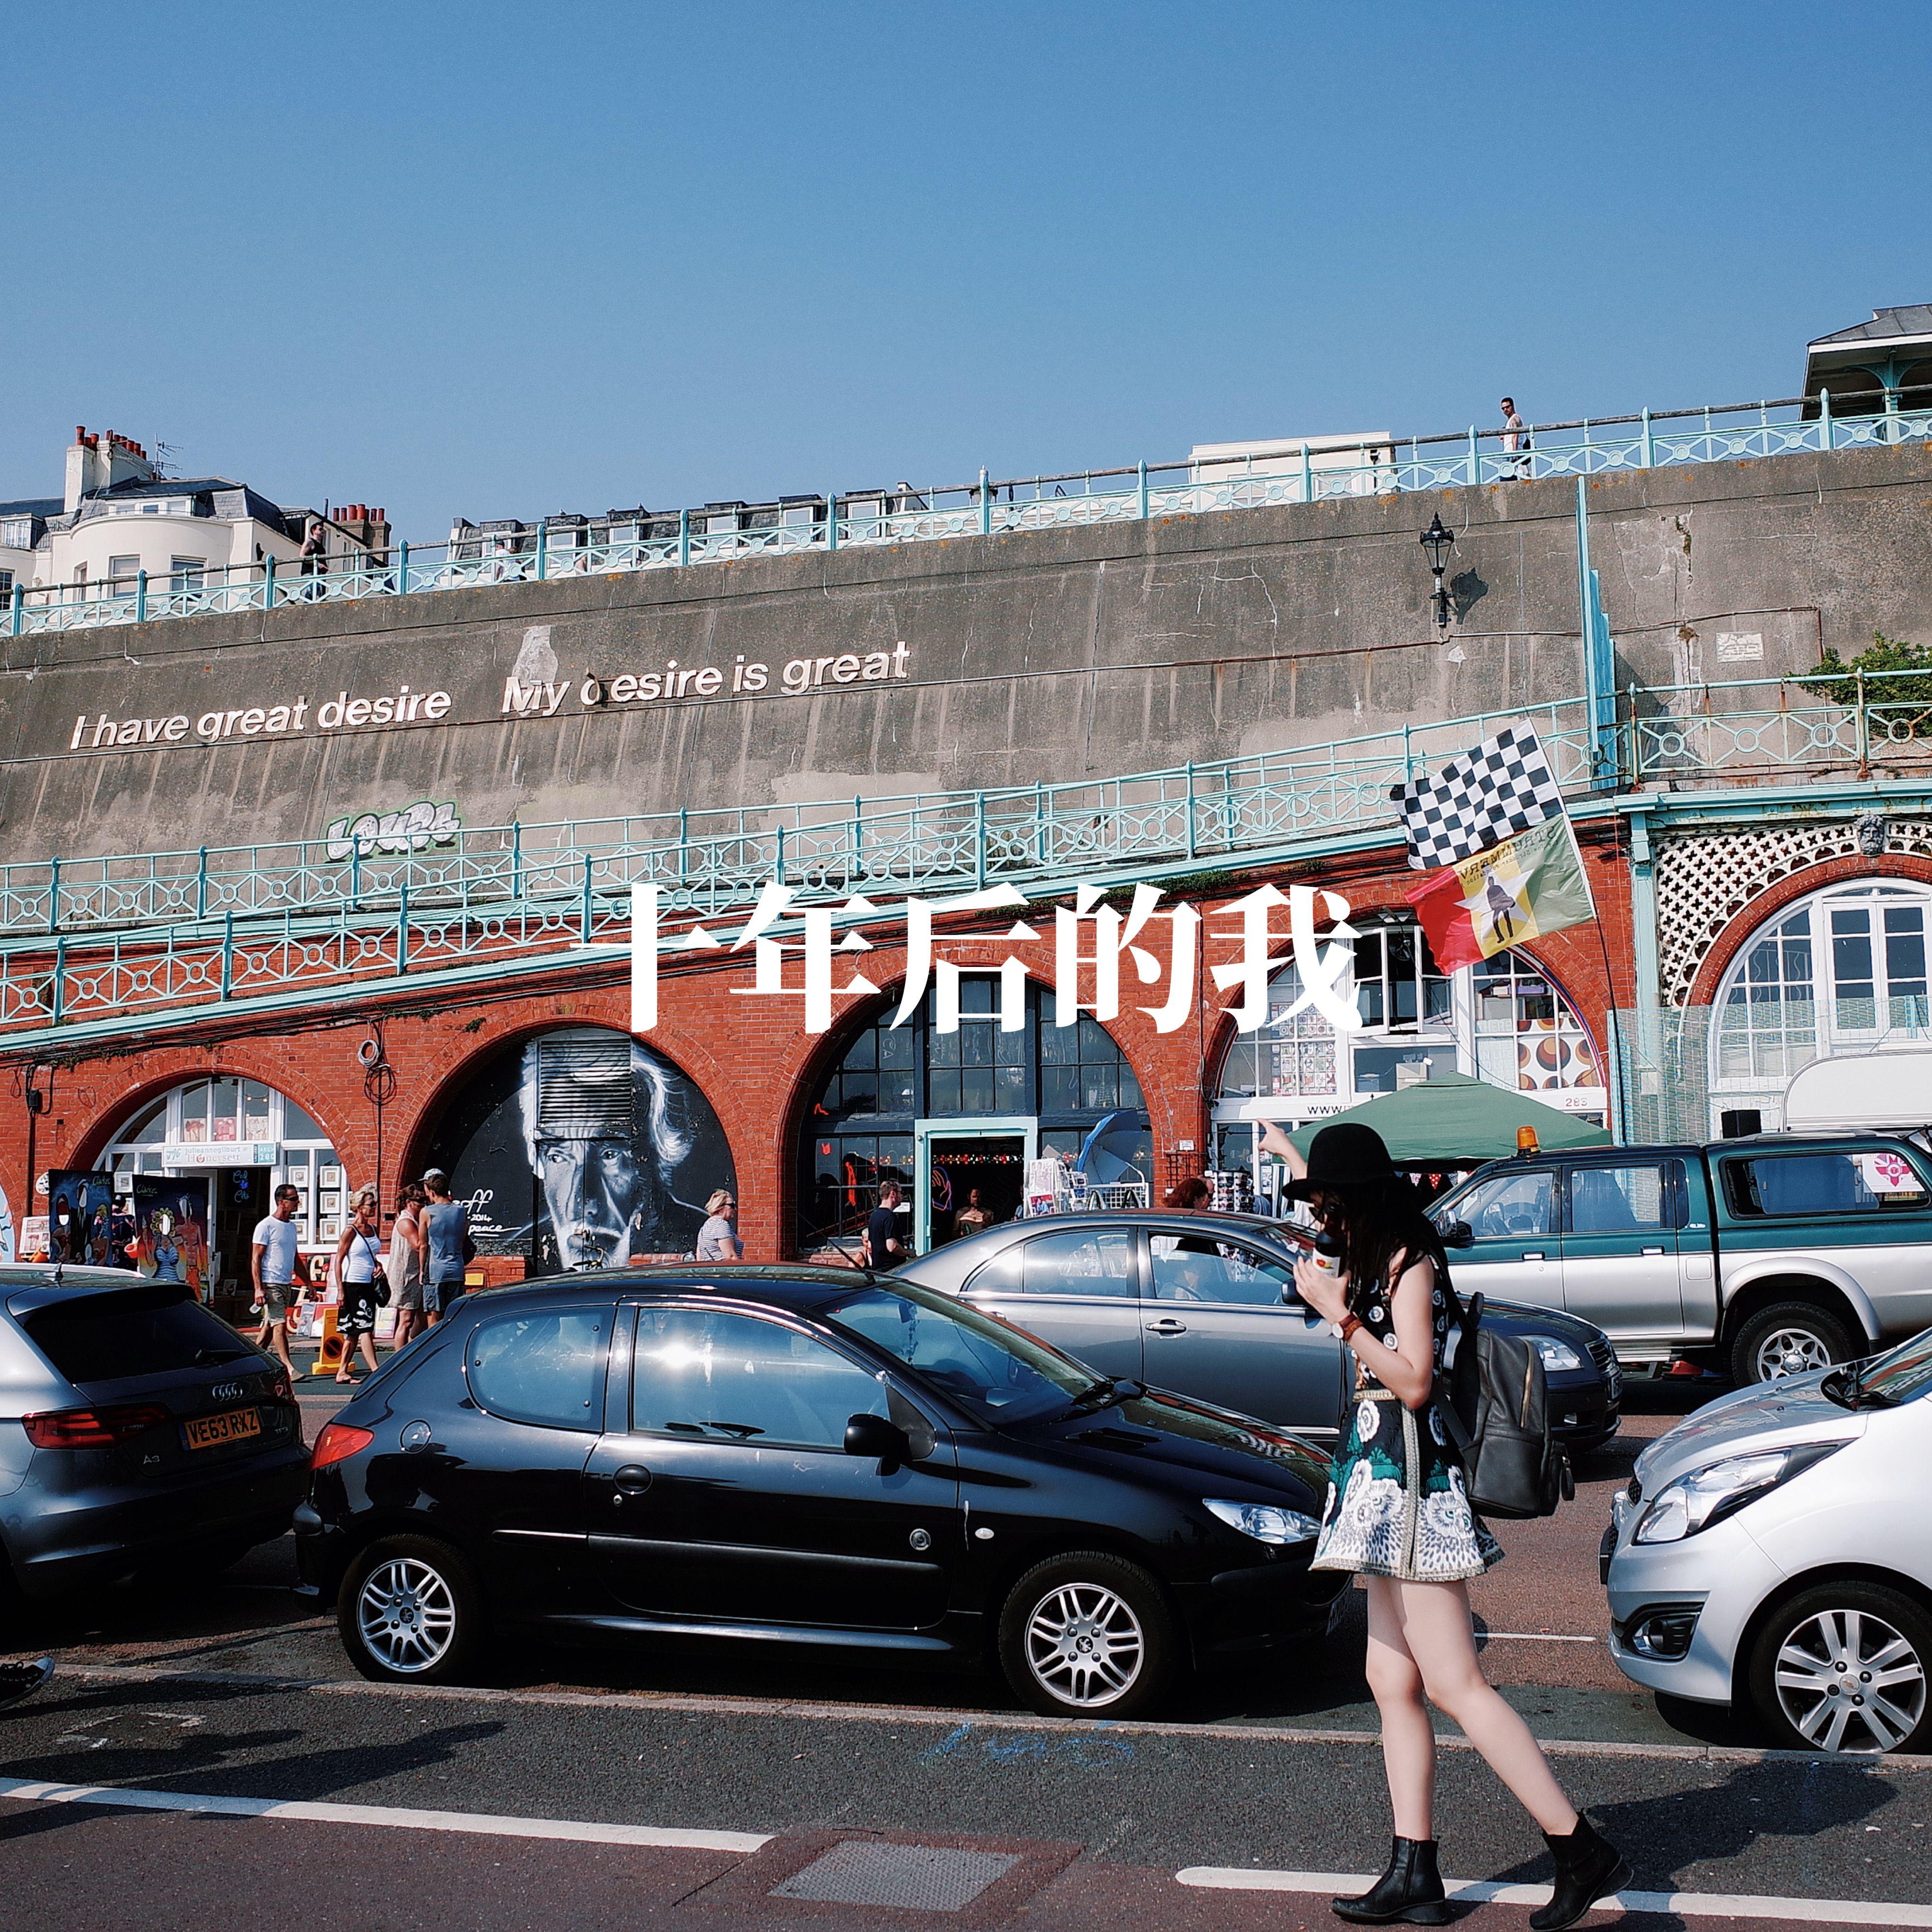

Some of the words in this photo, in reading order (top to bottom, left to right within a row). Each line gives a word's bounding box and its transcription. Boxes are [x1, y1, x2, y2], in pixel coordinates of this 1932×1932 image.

[502, 677, 571, 716] My
[733, 655, 769, 692] is
[780, 640, 910, 695] great
[70, 715, 87, 750] I
[92, 714, 189, 748] have
[195, 695, 308, 743] great
[317, 685, 452, 728] desire
[468, 1224, 522, 1236] peace
[188, 1417, 228, 1444] VE63
[229, 1410, 258, 1435] RXZ
[143, 1454, 160, 1464] A3
